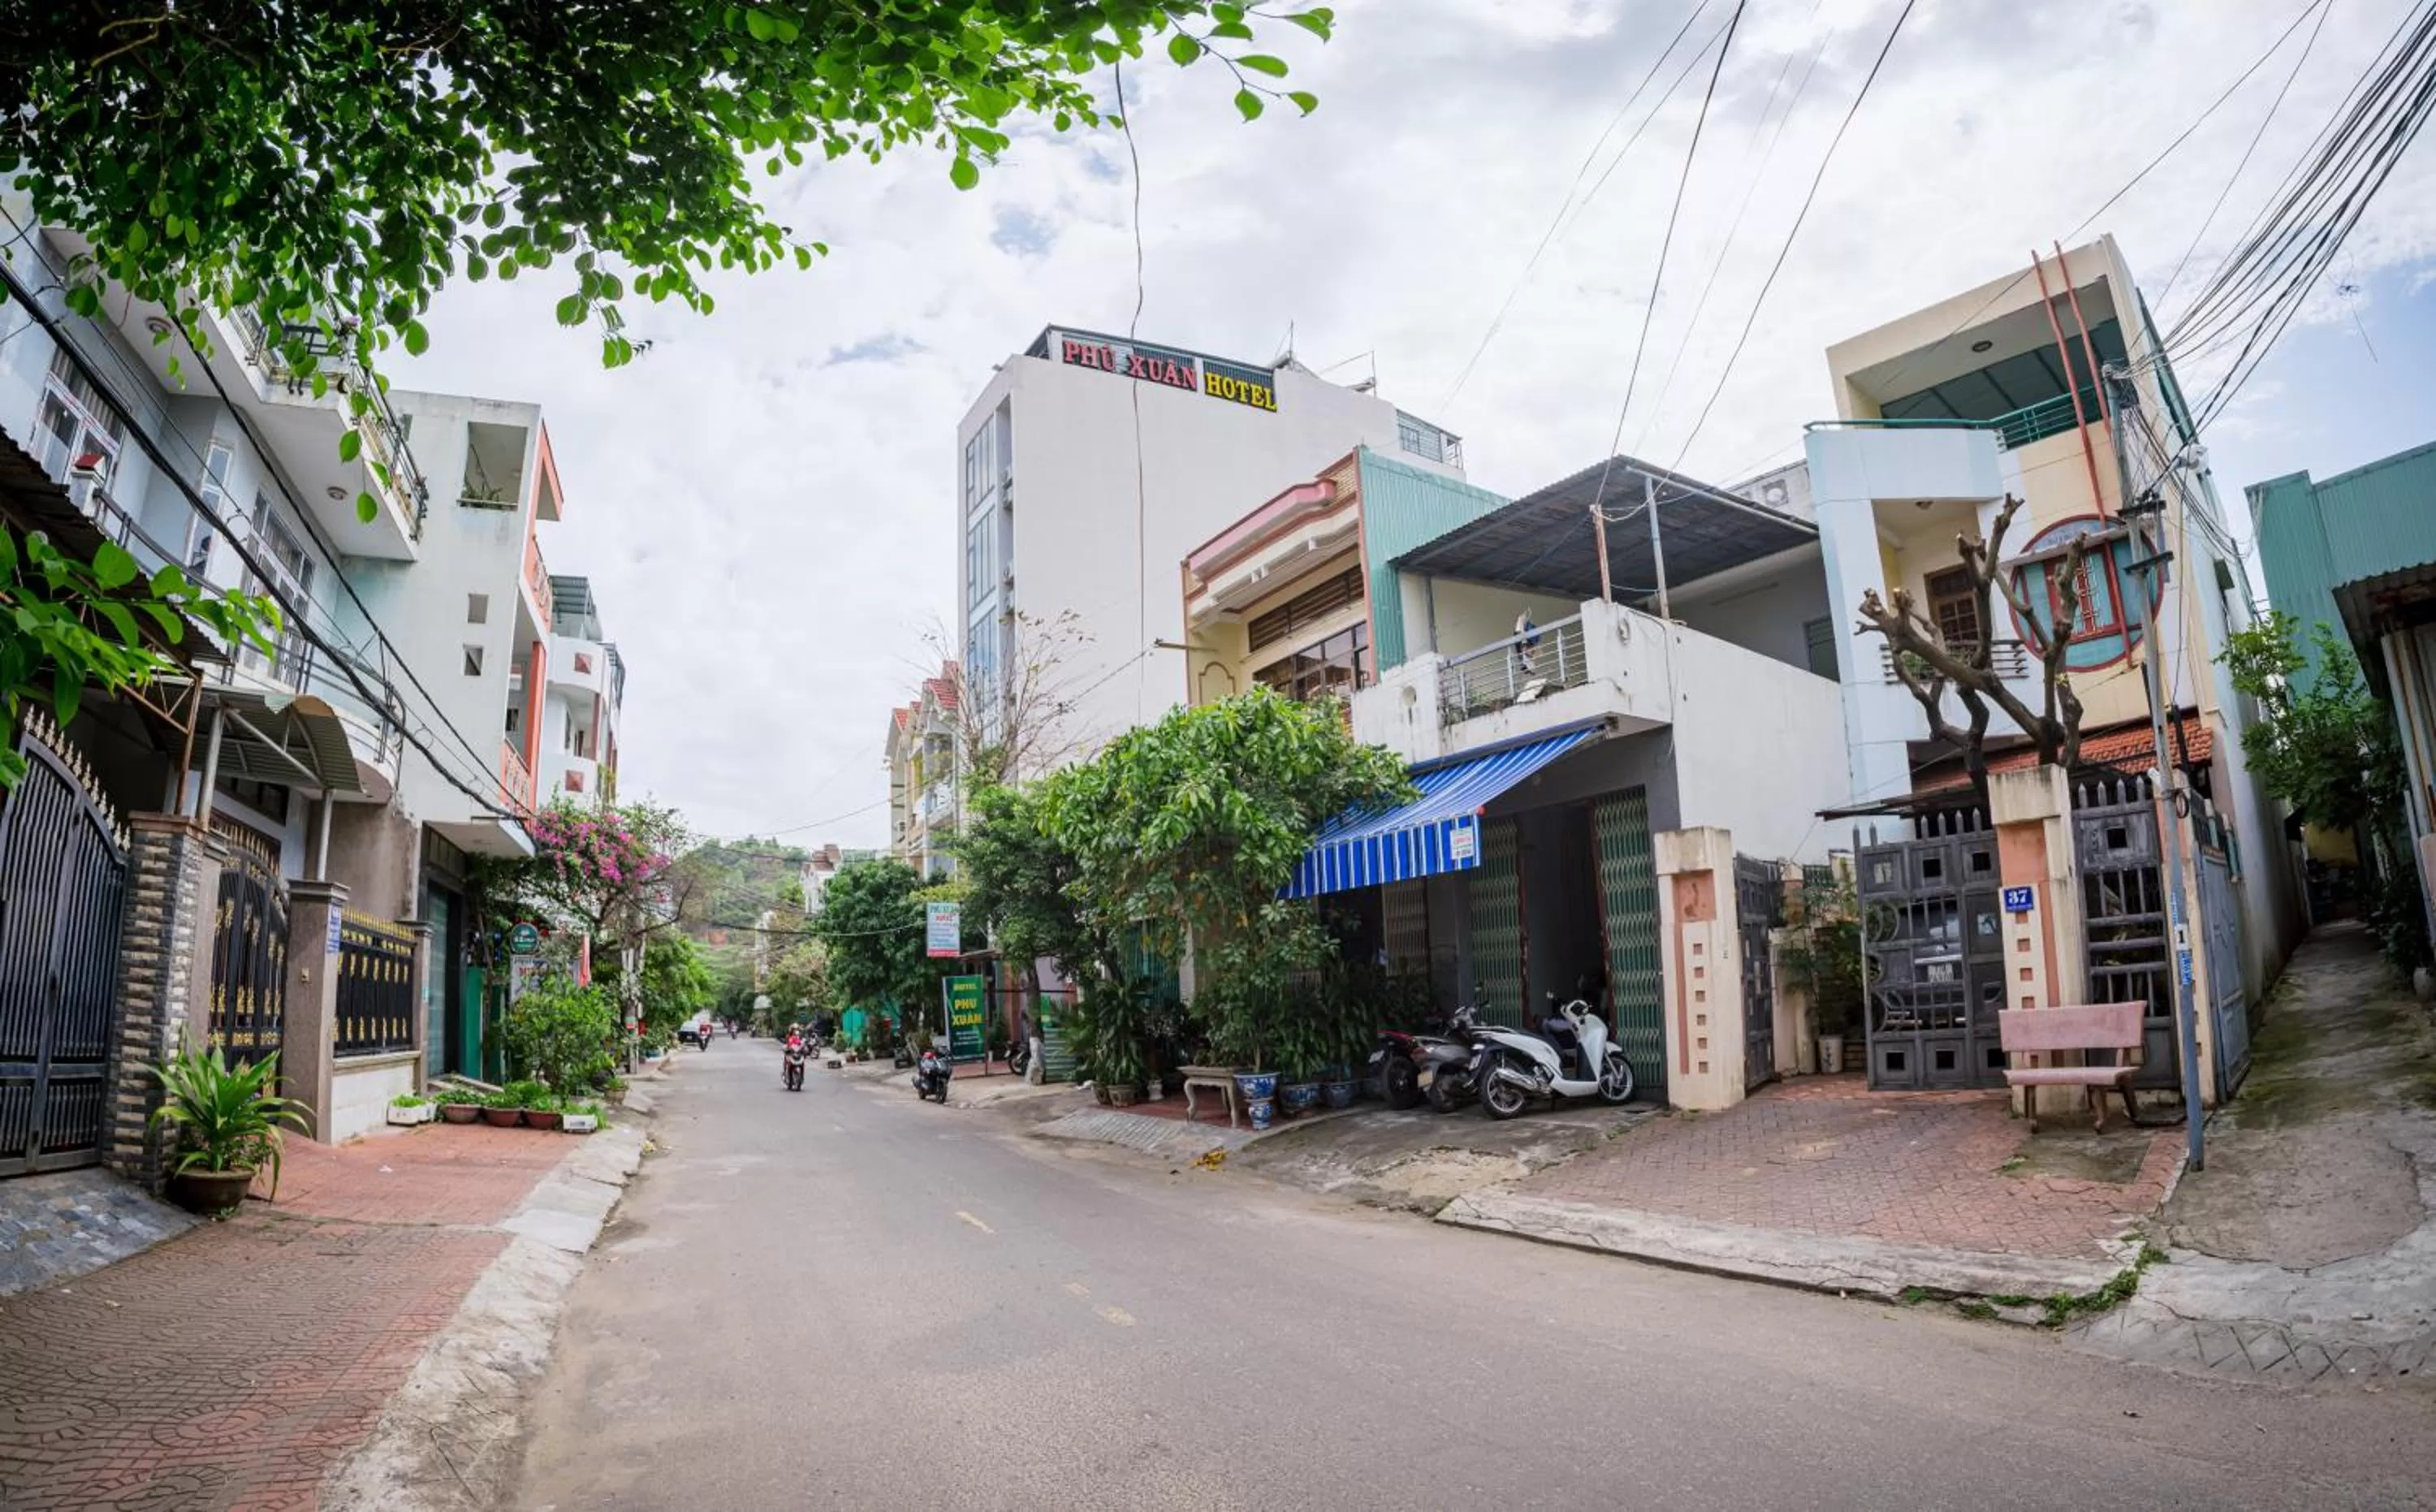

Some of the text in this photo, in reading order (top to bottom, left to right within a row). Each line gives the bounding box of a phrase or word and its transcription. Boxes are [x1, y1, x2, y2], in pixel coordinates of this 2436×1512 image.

[1128, 354, 1197, 391] XUÂN
[1205, 371, 1277, 413] HOTEL
[2008, 889, 2028, 904] 37
[2178, 929, 2185, 944] 1
